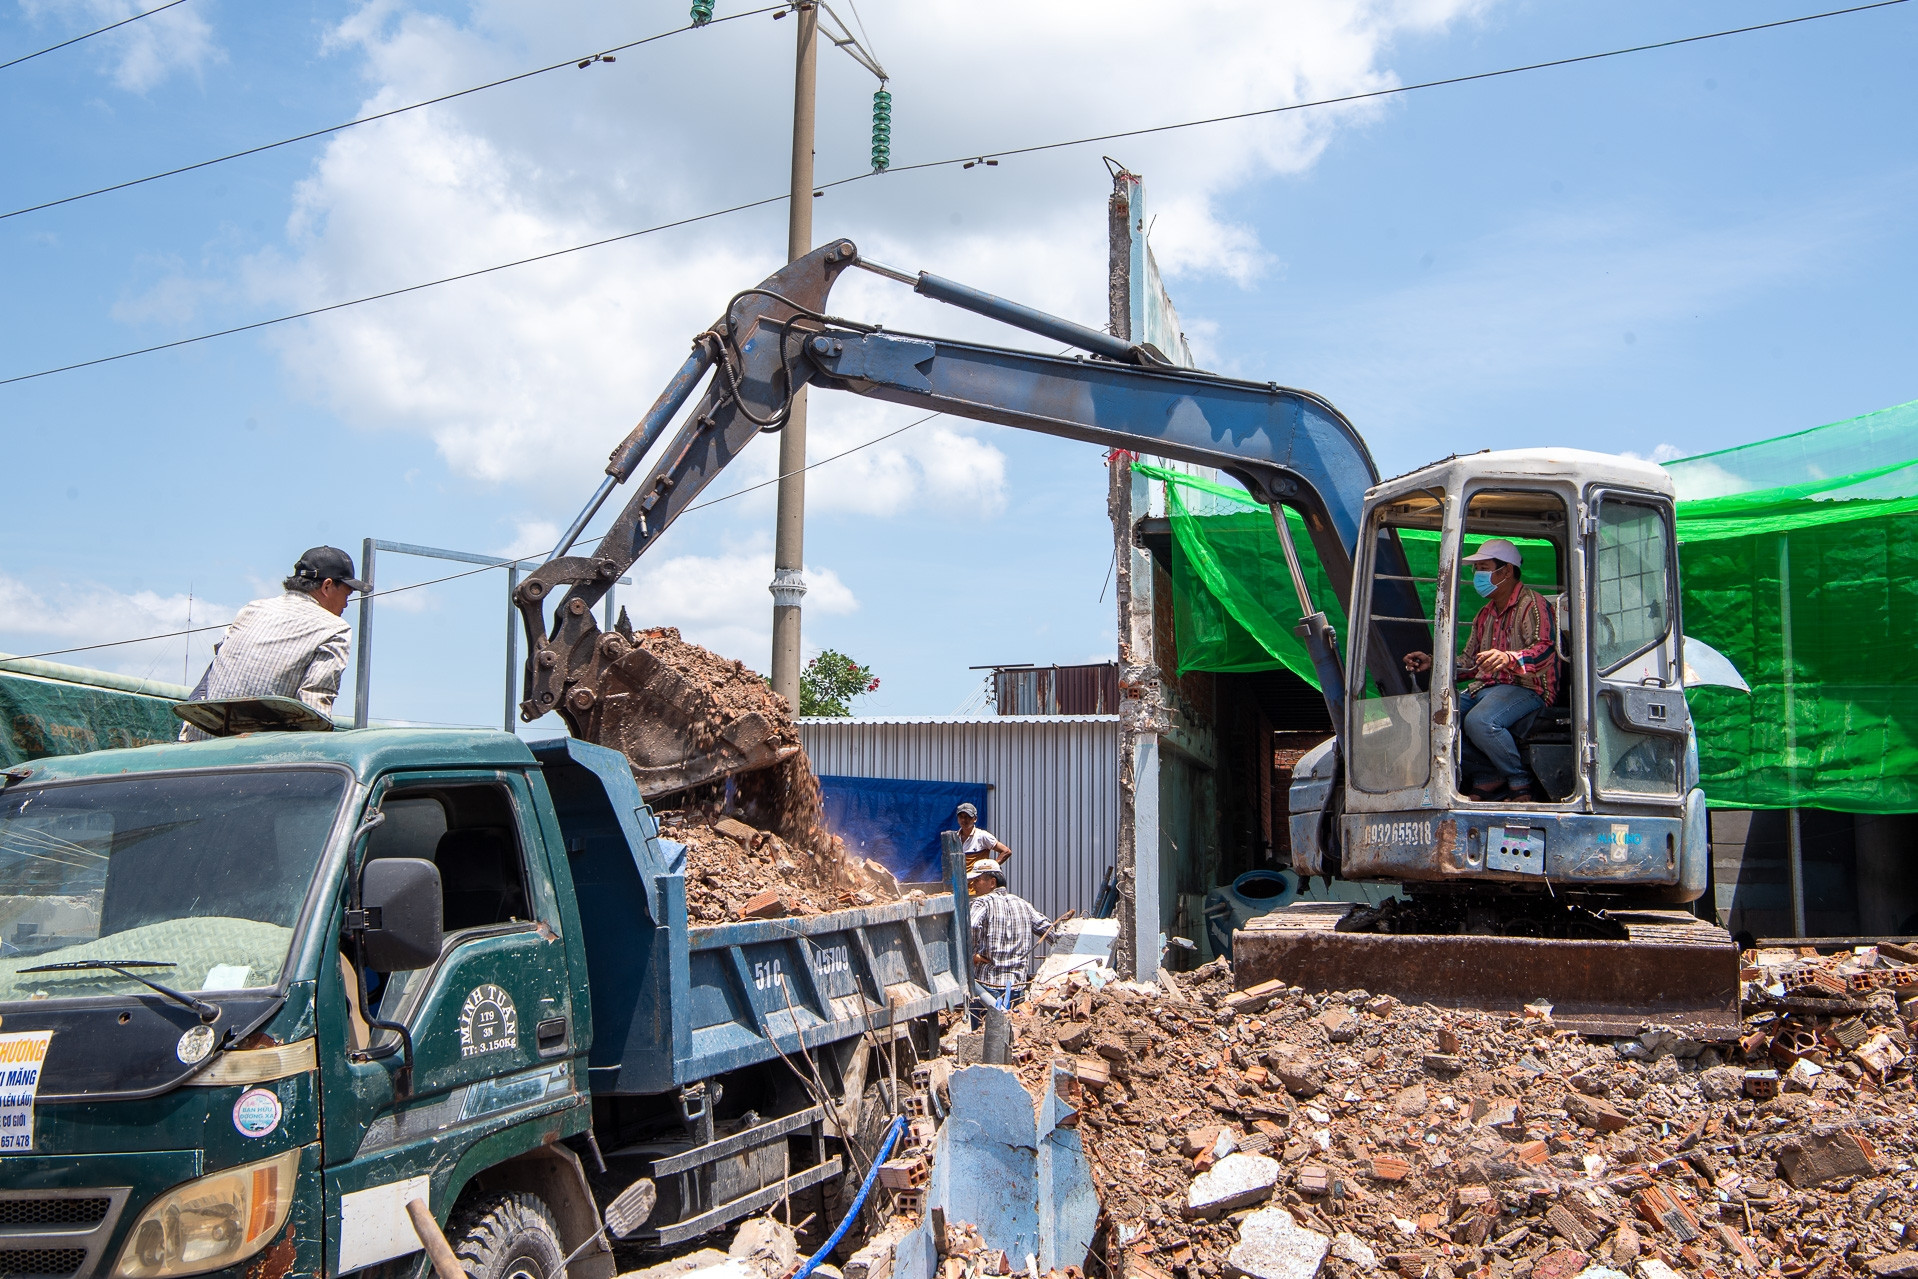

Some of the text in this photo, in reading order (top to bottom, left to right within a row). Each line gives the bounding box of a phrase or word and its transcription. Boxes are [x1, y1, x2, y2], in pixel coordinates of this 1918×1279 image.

[815, 945, 849, 976] 45709
[461, 987, 484, 1045] MINH
[480, 1011, 495, 1022] 1T9
[483, 1027, 494, 1038] 3N
[461, 1037, 517, 1057] TT: 3.150Kg
[6, 1067, 37, 1087] MĂNG
[1, 1134, 30, 1148] 657 478
